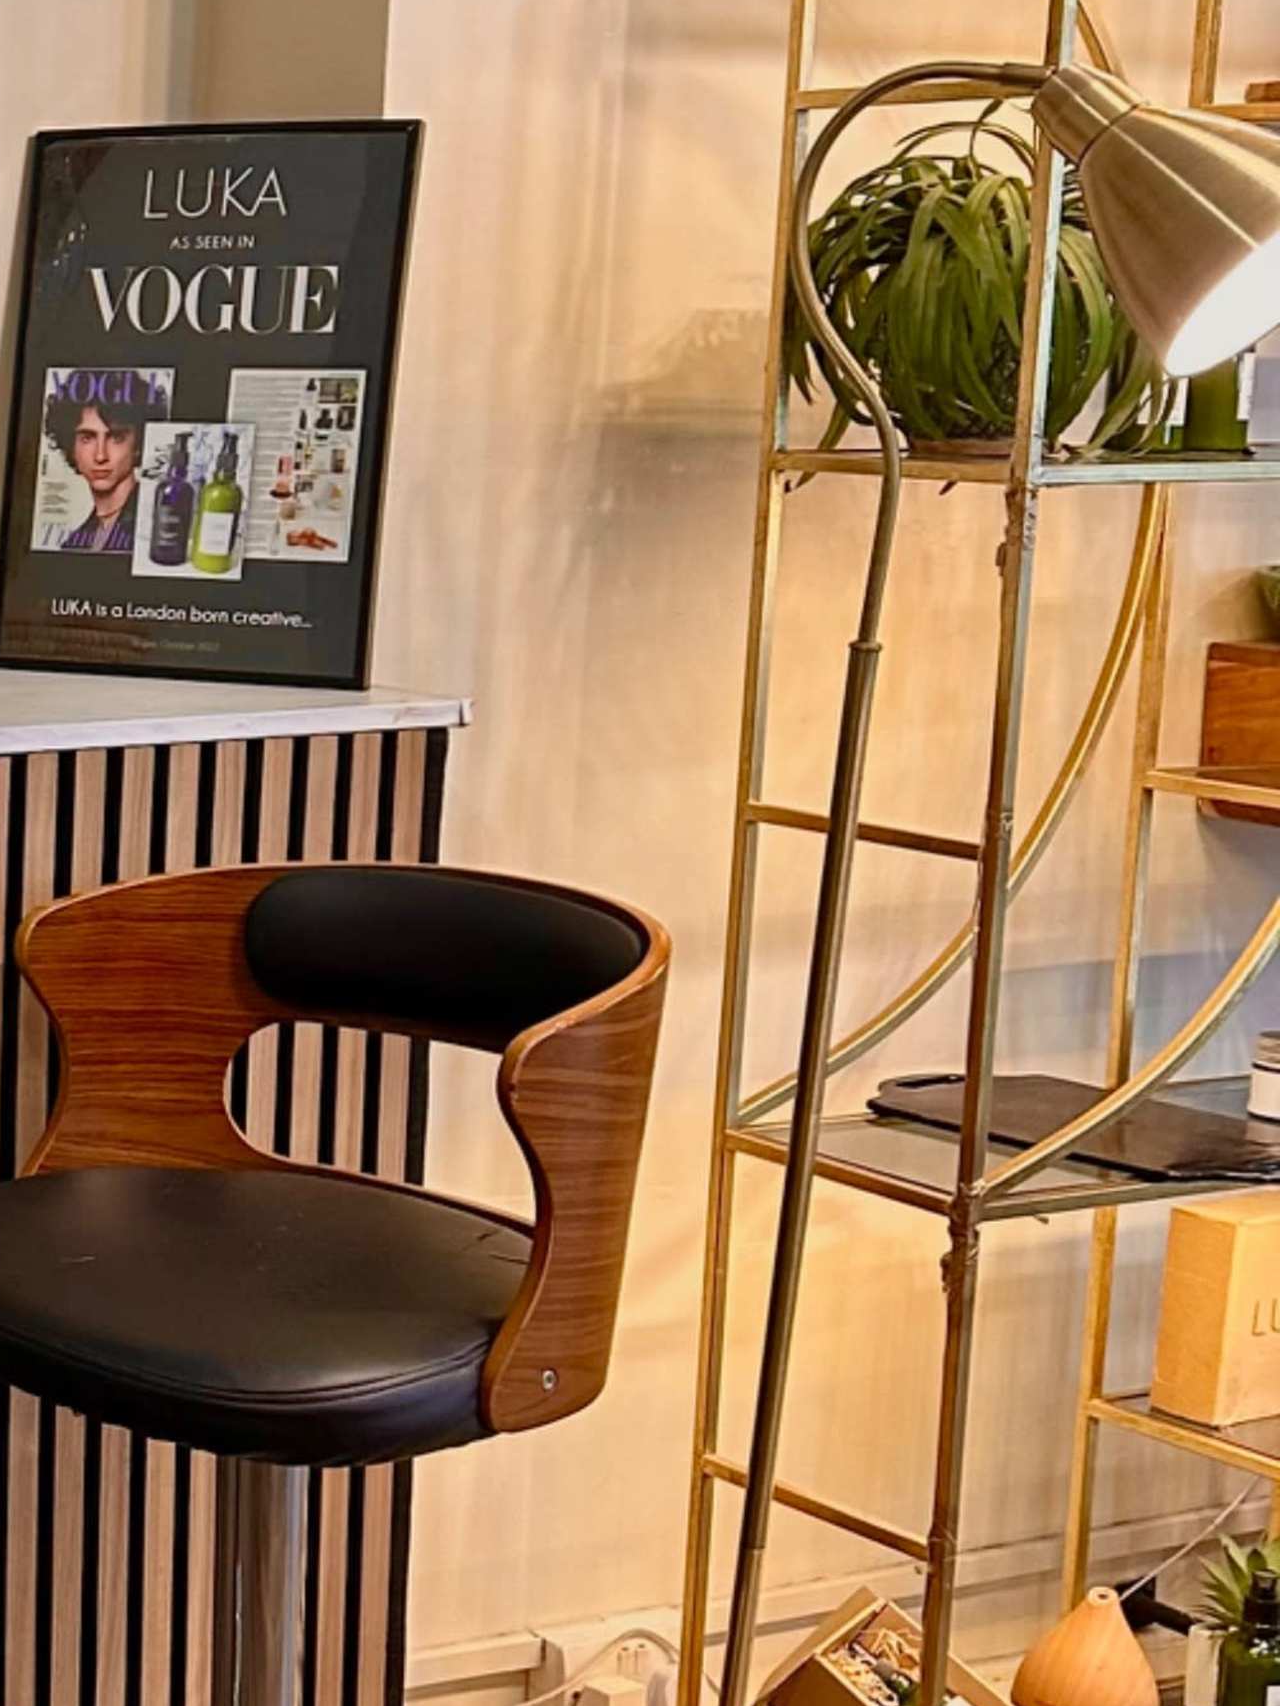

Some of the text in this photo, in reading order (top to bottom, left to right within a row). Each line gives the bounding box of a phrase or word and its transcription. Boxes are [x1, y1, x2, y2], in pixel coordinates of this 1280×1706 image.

[143, 166, 288, 219] LUKA
[169, 234, 256, 250] AS SEEN IN
[85, 263, 339, 335] VOGUE
[51, 598, 91, 616] LUKA
[95, 603, 108, 618] is
[111, 606, 123, 619] a
[126, 602, 186, 622] London
[190, 606, 230, 624] born
